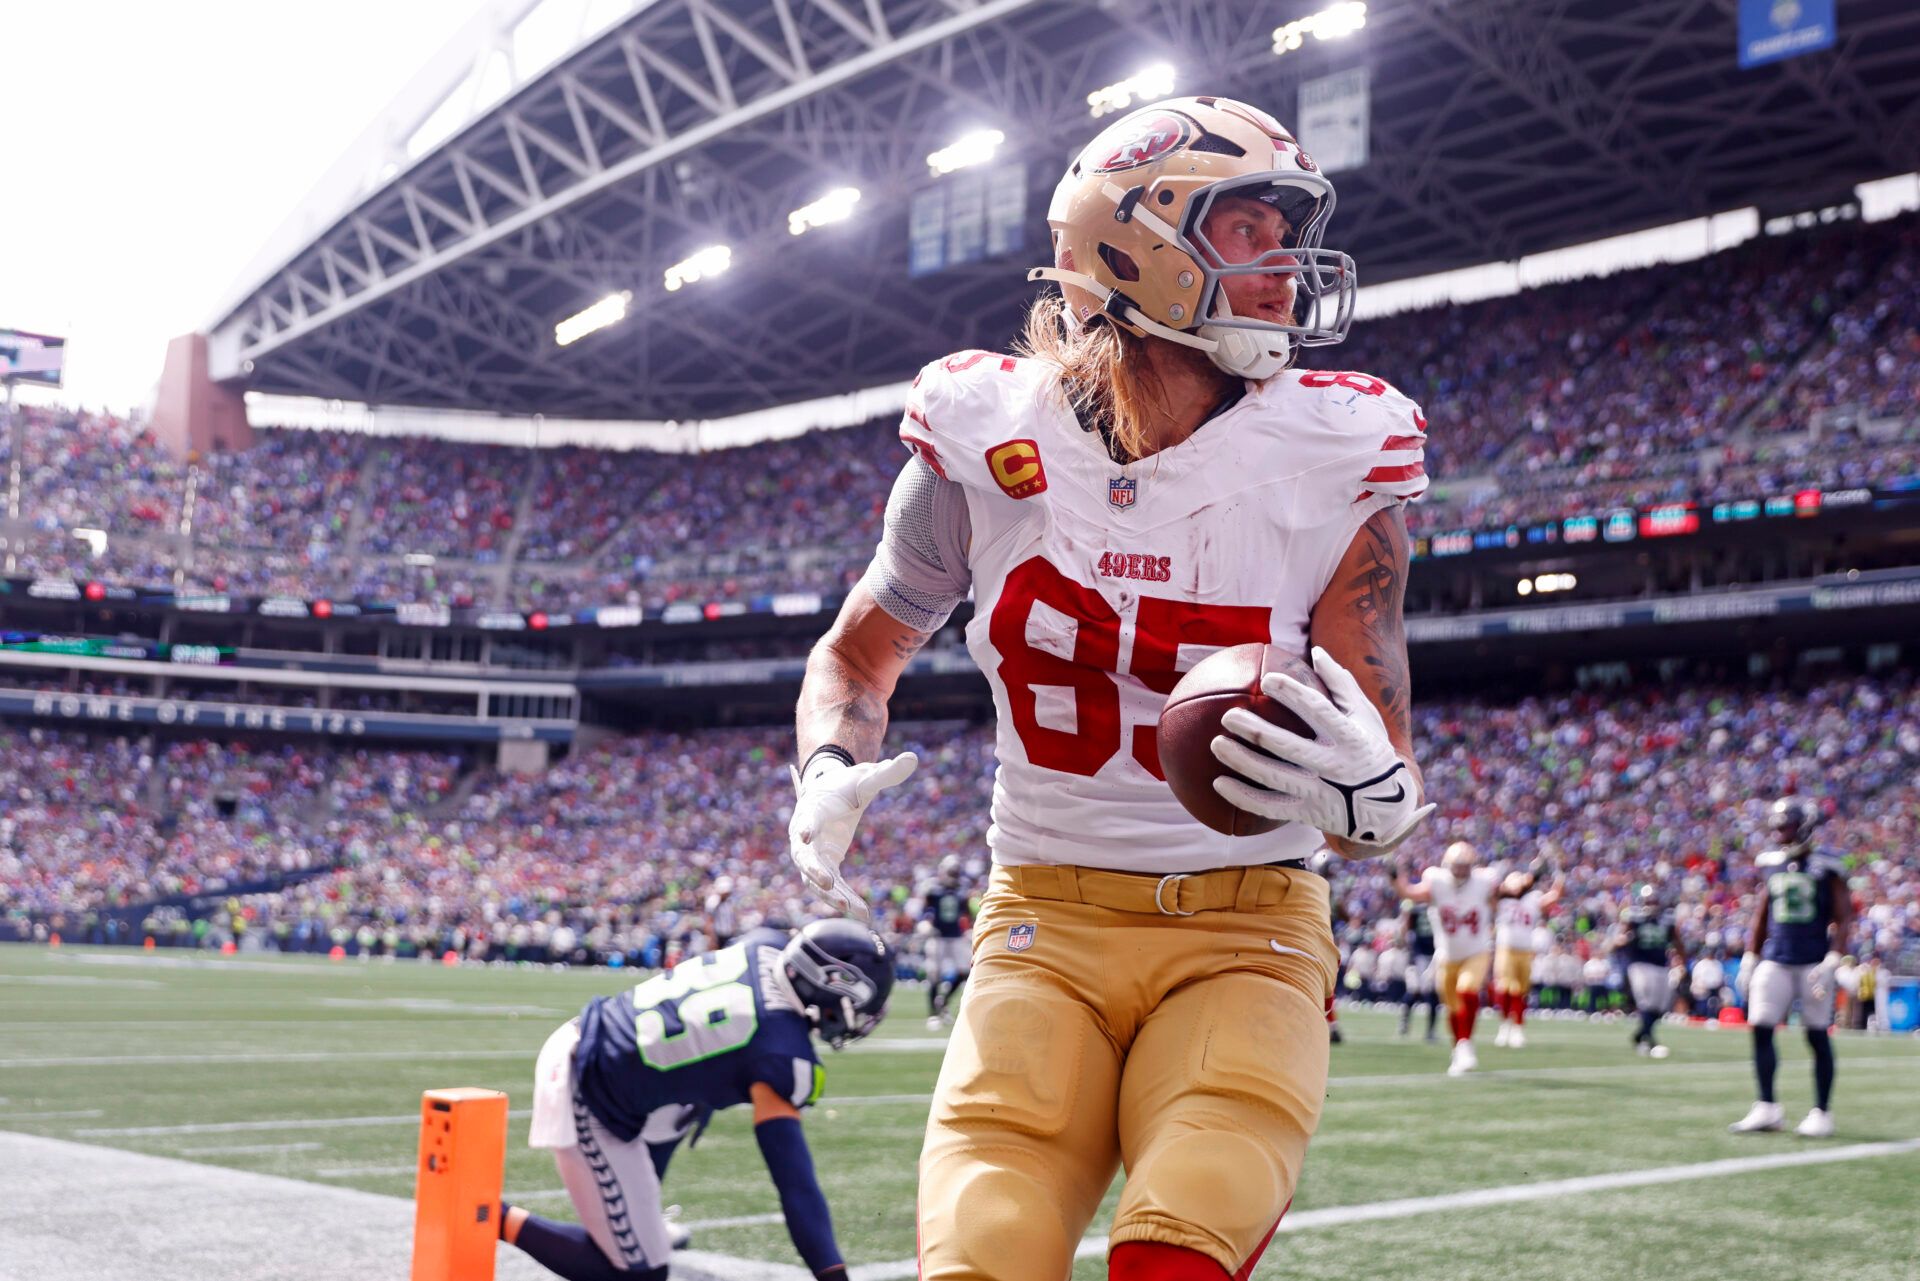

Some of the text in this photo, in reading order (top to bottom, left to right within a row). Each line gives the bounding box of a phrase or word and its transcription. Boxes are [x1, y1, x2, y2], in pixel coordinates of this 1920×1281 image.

[991, 443, 1039, 488] C
[1112, 489, 1133, 504] NFL
[1098, 551, 1171, 582] 49ERS
[989, 555, 1272, 782] 85
[33, 694, 134, 720] HOME
[157, 701, 198, 725] OF
[224, 705, 286, 731] THE
[633, 942, 758, 1072] 39
